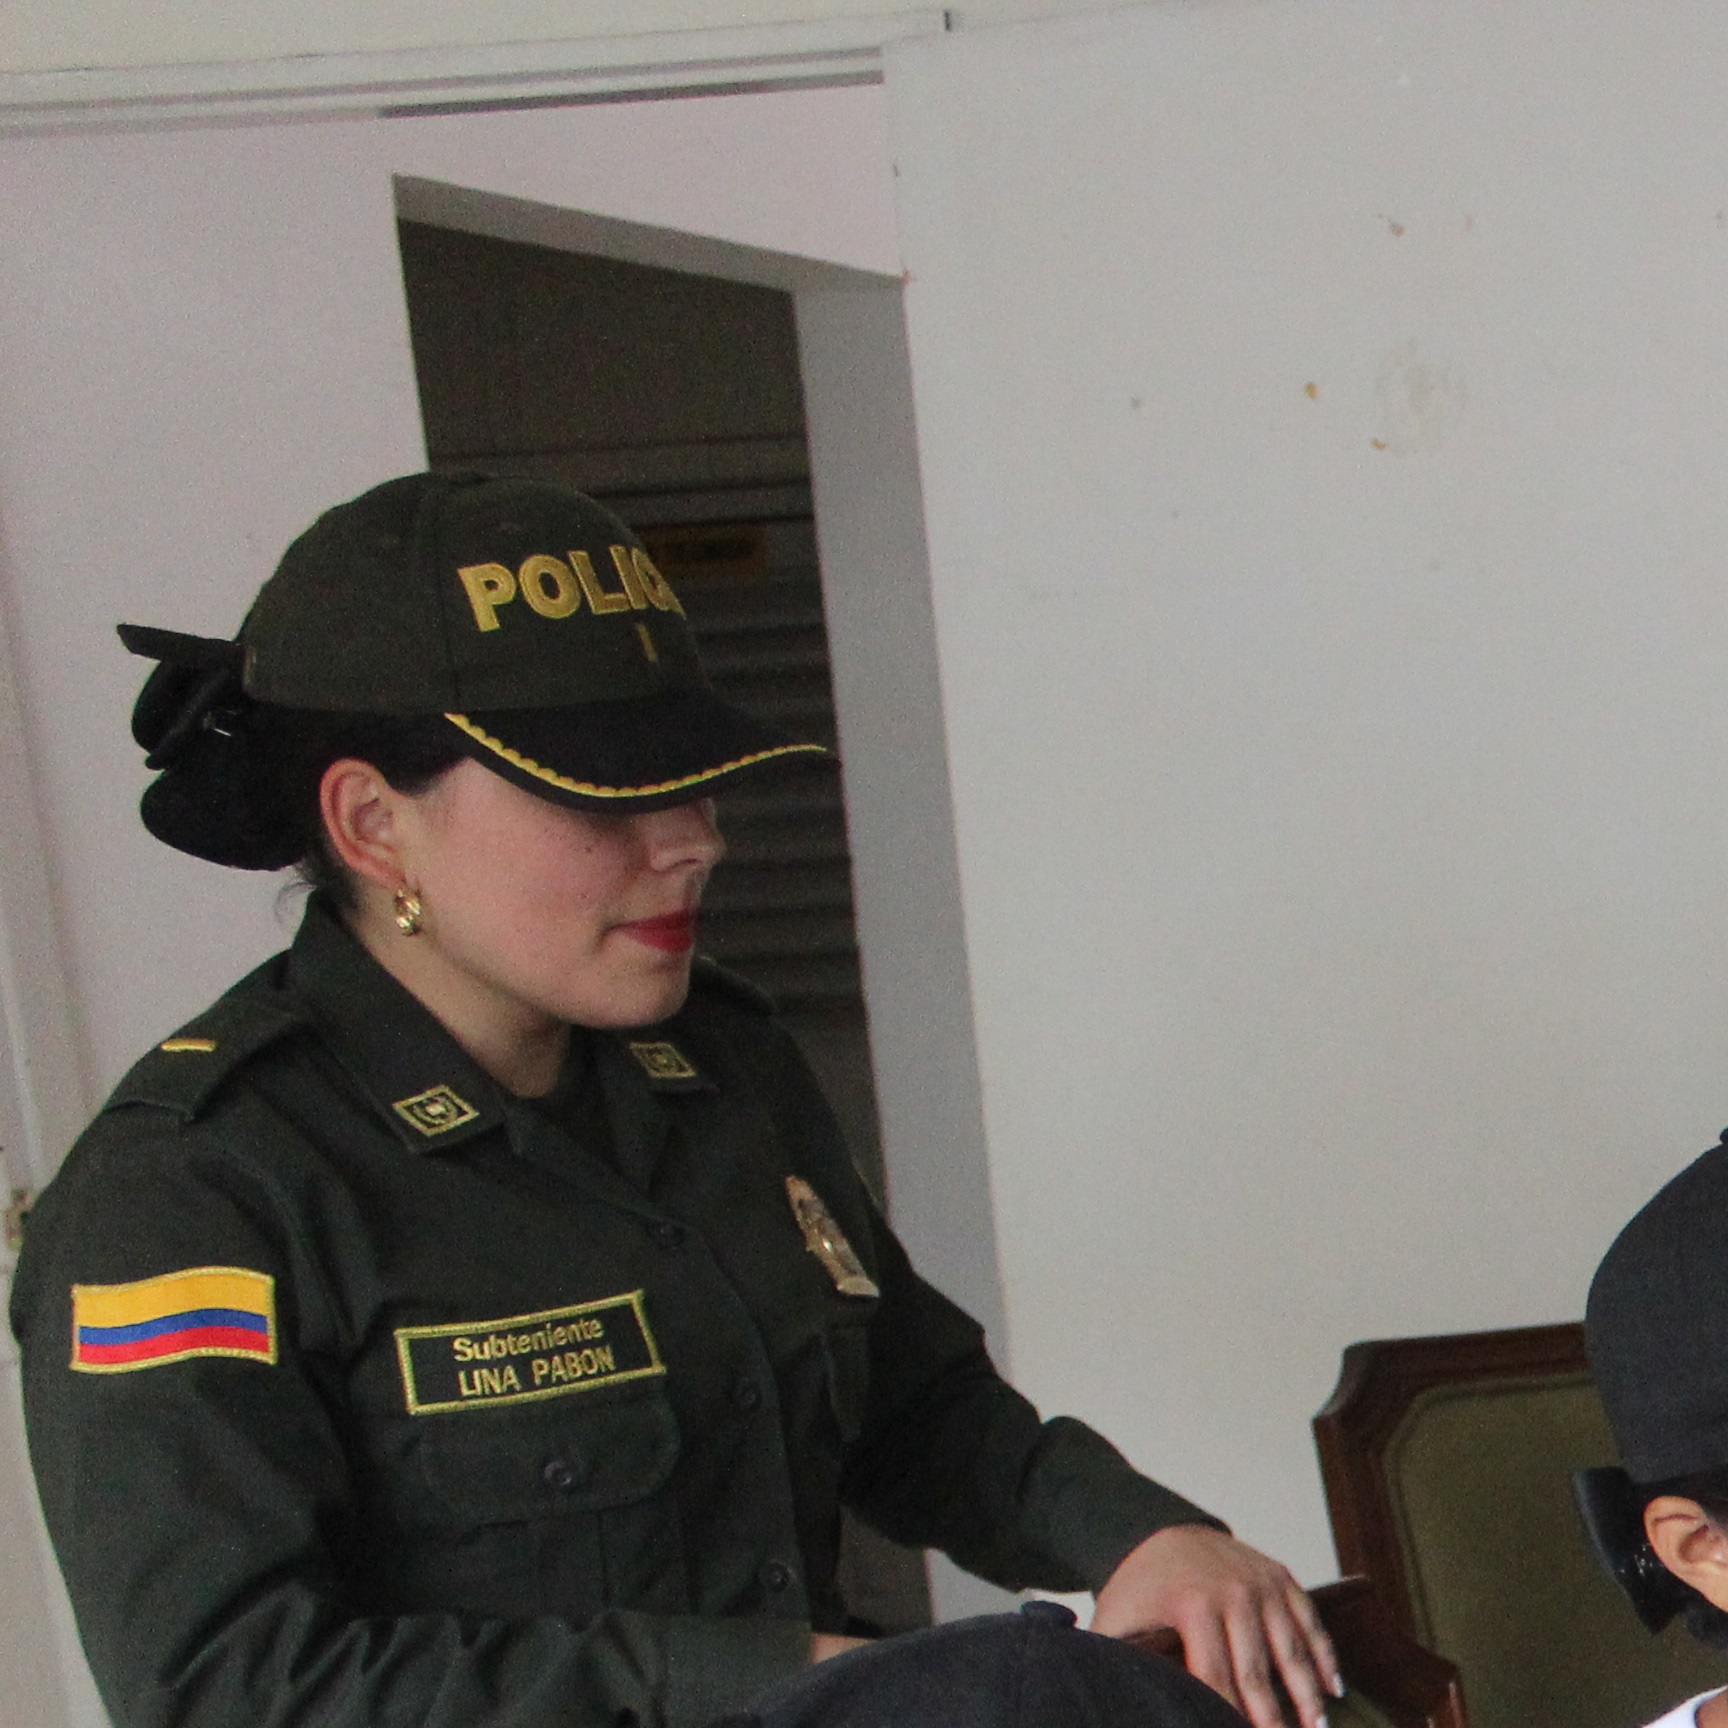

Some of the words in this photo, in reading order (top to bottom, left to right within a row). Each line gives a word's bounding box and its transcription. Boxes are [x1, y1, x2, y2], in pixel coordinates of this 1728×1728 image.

[457, 545, 686, 632] POLIC
[454, 1319, 604, 1362] Subteniente
[458, 1365, 522, 1397] LINA
[531, 1344, 617, 1386] PABON
